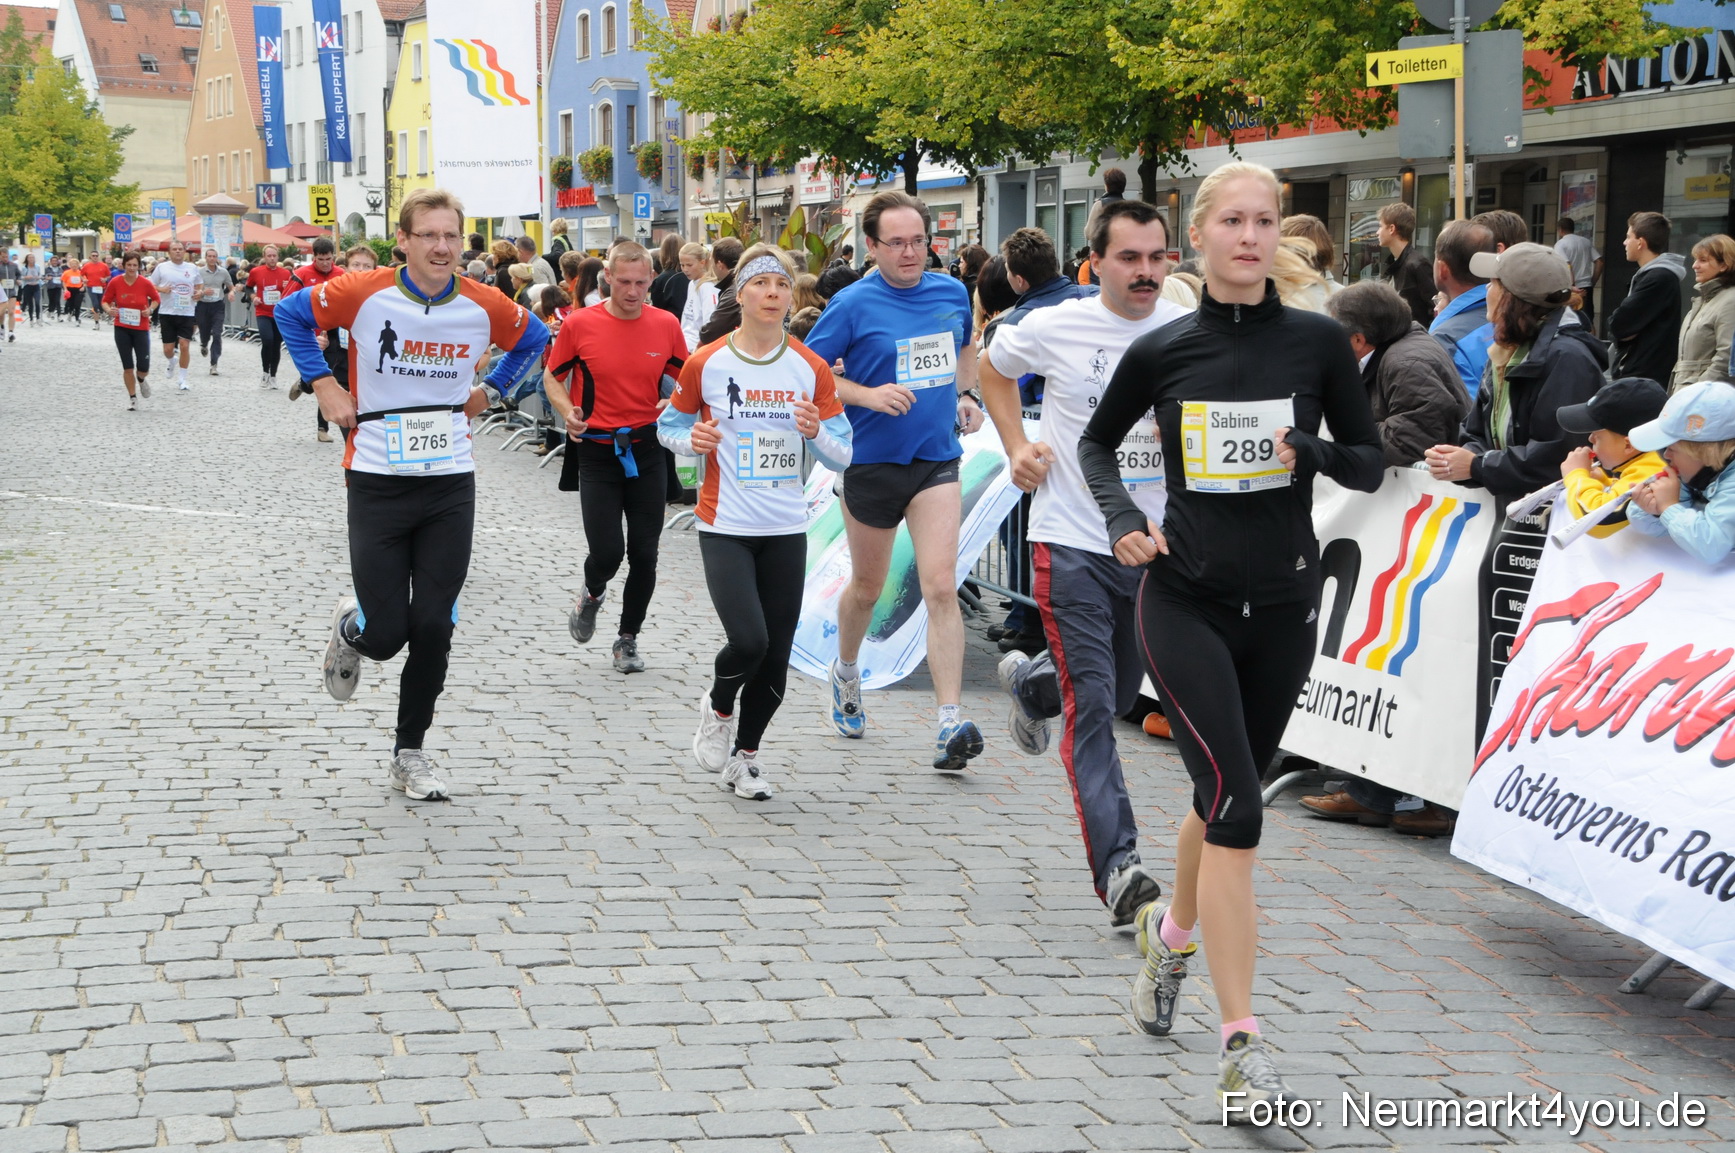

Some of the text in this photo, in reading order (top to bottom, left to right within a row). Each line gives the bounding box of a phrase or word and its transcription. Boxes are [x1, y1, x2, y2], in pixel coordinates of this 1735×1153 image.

[1386, 58, 1448, 75] Toiletten
[331, 54, 344, 113] RUPPERT
[311, 186, 333, 194] Block
[316, 197, 330, 217] B
[636, 195, 648, 216] P
[403, 339, 470, 358] MERZ
[913, 341, 939, 352] Thomas
[398, 349, 455, 367] Reisen
[913, 352, 949, 370] 2631
[390, 366, 458, 380] TEAM 2008
[743, 397, 786, 409] Reisen
[746, 389, 796, 402] MERZ
[739, 411, 791, 420] TEAM 2008
[1211, 411, 1259, 428] Sabine
[406, 418, 434, 431] Holger
[391, 436, 397, 445] A
[409, 433, 448, 451] 2765
[758, 436, 785, 449] Margit
[1186, 437, 1193, 450] D
[1222, 438, 1274, 464] 289
[759, 452, 796, 469] 2766
[1117, 451, 1162, 469] 2630
[1251, 473, 1289, 485] PFLEIDERER
[1293, 674, 1398, 739] eumarkt
[1493, 763, 1669, 864] Ostbayerns
